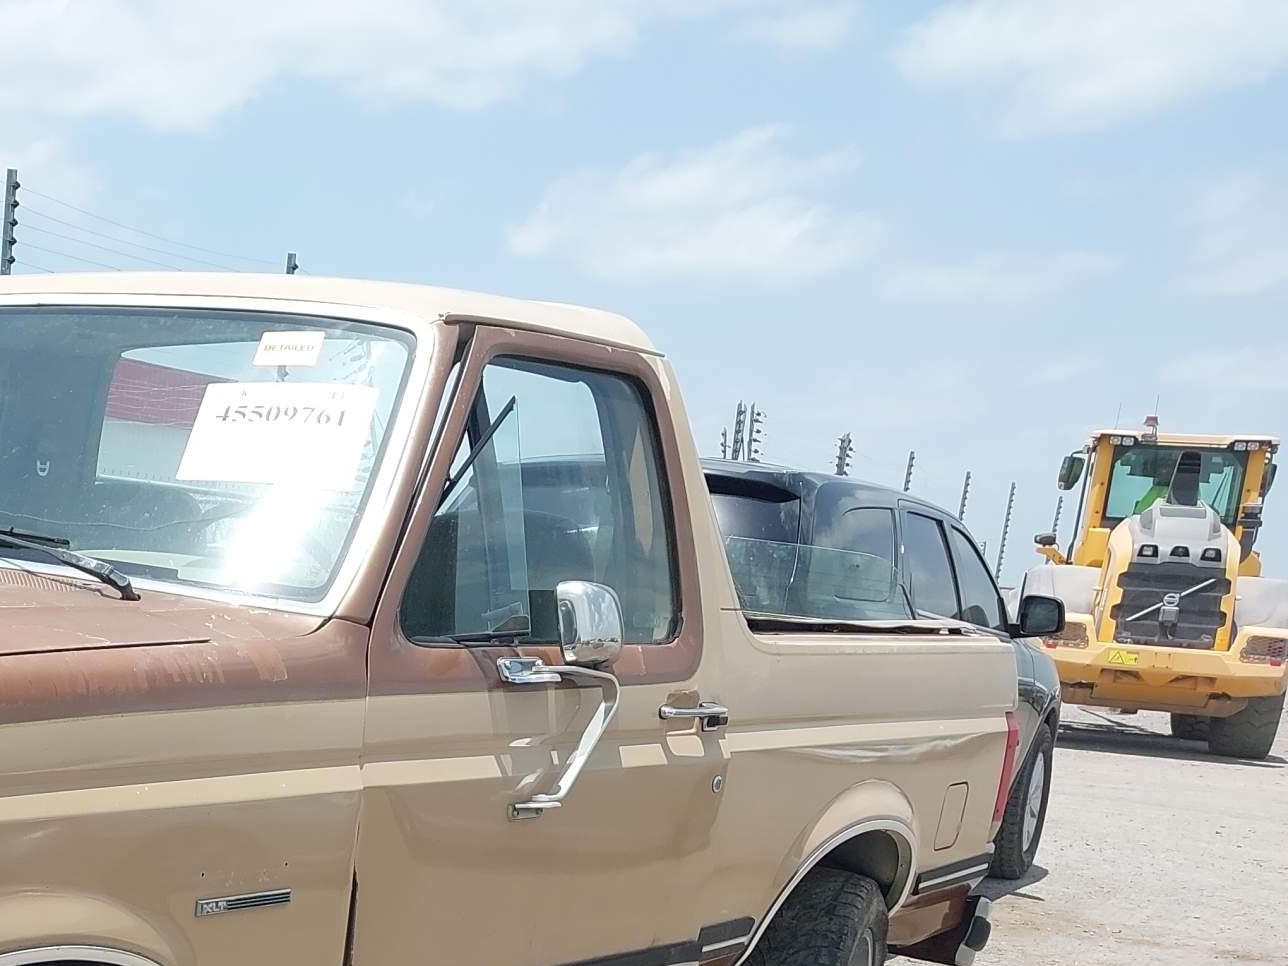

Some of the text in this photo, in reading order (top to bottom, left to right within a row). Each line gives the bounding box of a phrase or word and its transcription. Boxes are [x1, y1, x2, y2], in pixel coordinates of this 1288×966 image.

[263, 343, 315, 352] DETAILED
[215, 405, 346, 427] 45509761
[202, 901, 227, 914] XLT
